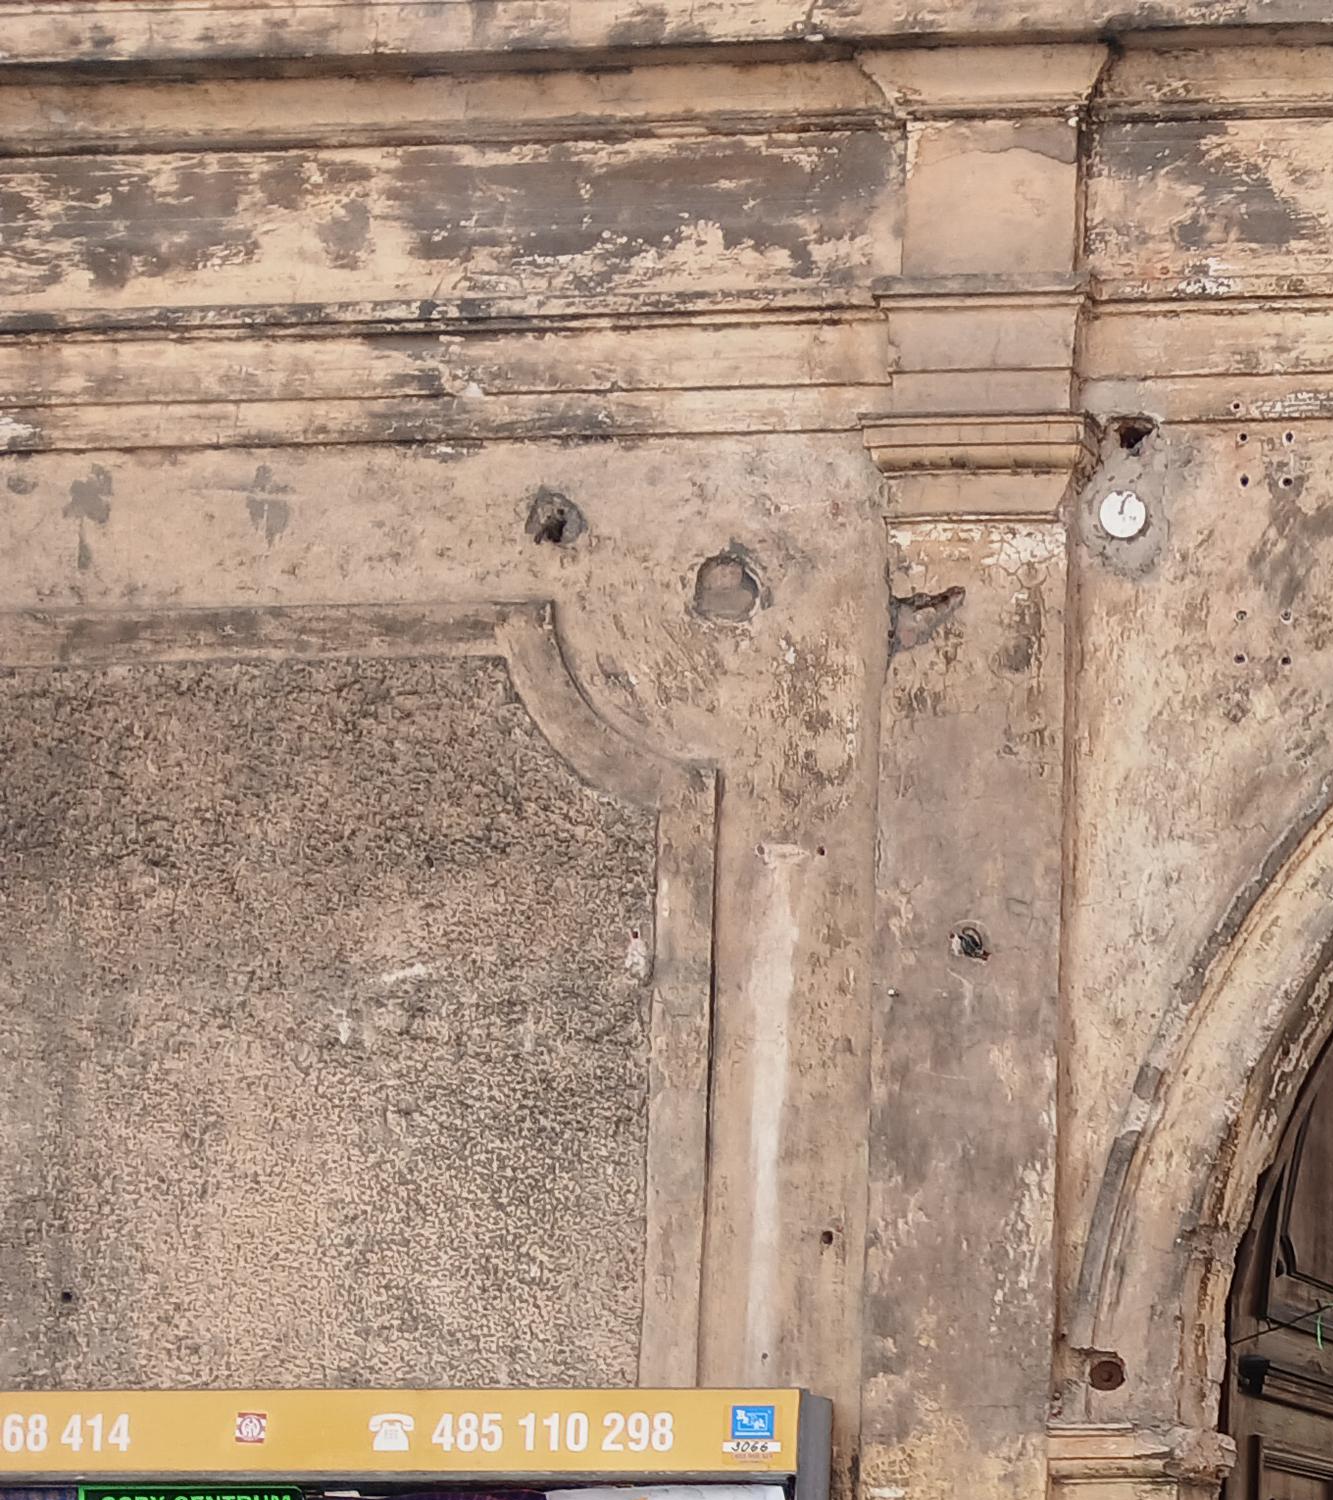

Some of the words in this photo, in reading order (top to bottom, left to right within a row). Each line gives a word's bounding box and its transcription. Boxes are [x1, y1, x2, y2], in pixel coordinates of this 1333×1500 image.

[61, 1413, 131, 1451] 414
[431, 1412, 503, 1451] 485
[518, 1412, 588, 1451] 110
[601, 1411, 674, 1451] 298
